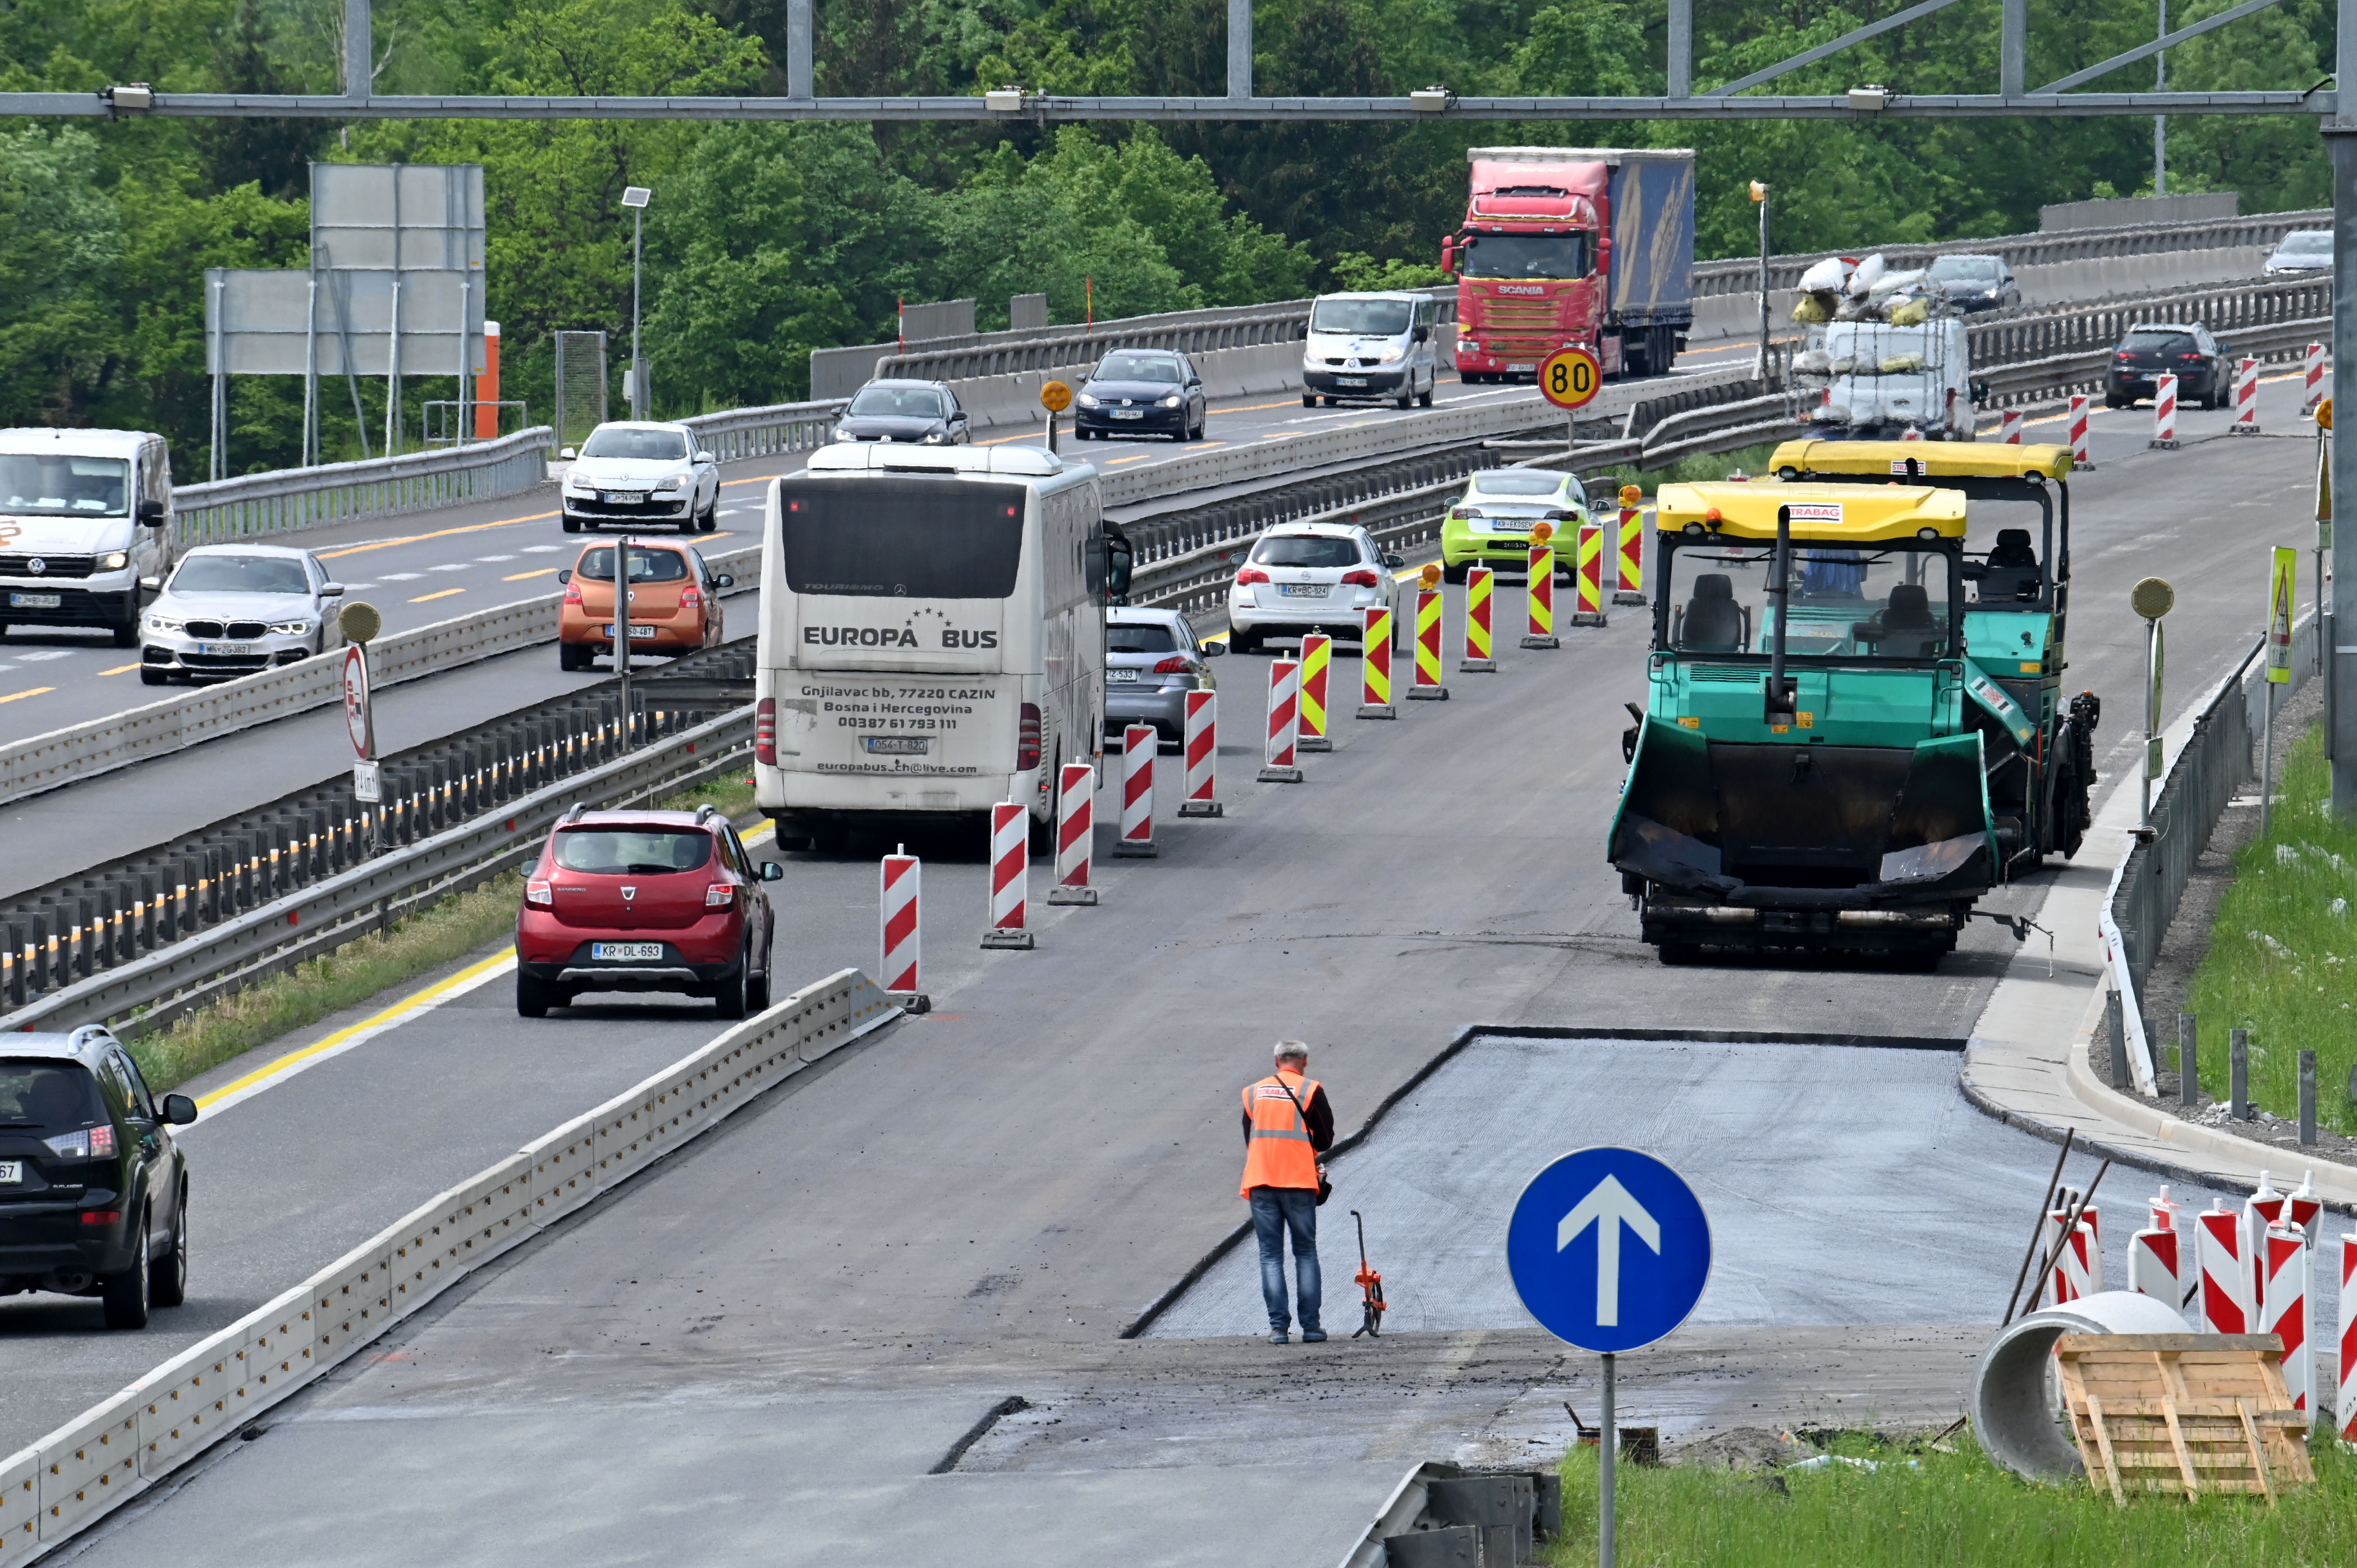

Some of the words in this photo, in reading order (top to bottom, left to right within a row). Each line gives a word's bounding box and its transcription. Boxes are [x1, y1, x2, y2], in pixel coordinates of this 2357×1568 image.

[1498, 285, 1544, 295] SCANIA
[1552, 363, 1590, 393] 80
[1789, 508, 1840, 517] TRABAG
[804, 627, 918, 647] EUROPA
[942, 629, 997, 649] BUS
[801, 686, 868, 698] Gnjilavac
[872, 687, 895, 699] bb,
[899, 689, 944, 699] 77220
[948, 690, 995, 699] CAZIN
[824, 702, 869, 712] Bosna
[873, 703, 877, 712] i
[881, 703, 972, 716] Hercegovina
[838, 717, 886, 728] 00387
[889, 719, 905, 728] 61
[909, 719, 936, 728] 793
[939, 719, 956, 728] 111
[817, 762, 977, 774] europabus_ch@live.com
[603, 946, 616, 957] KR
[624, 946, 659, 956] DL-693
